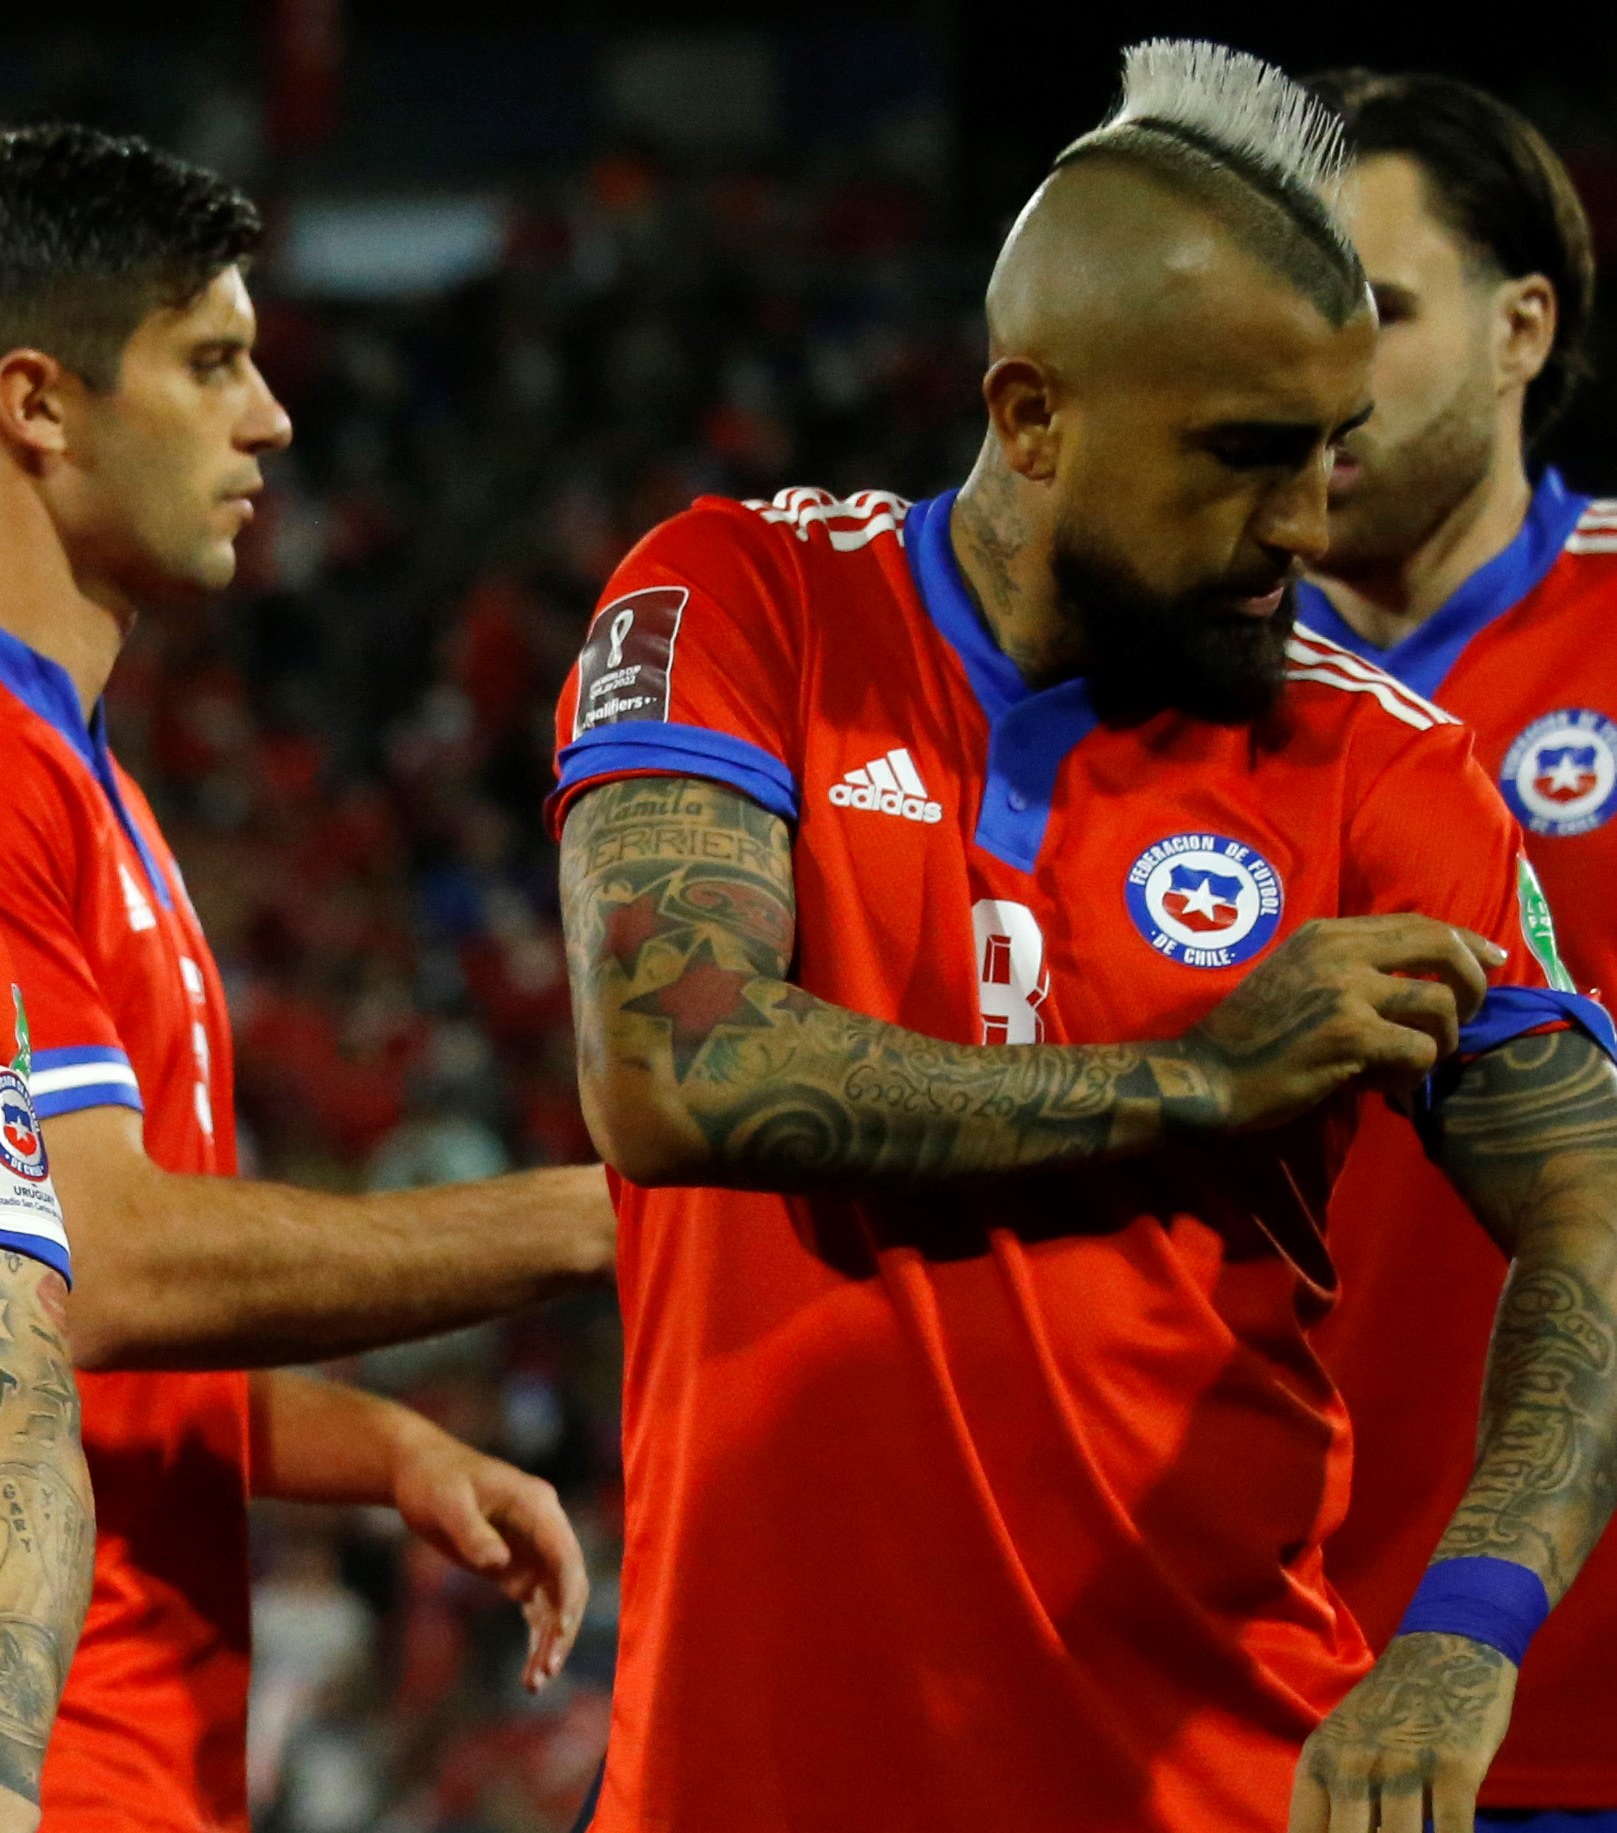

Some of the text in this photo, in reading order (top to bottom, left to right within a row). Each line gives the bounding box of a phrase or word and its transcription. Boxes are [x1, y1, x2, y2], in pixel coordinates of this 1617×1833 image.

[829, 785, 943, 824] adidas
[1129, 835, 1279, 916] FEDERACION DE FUTBOL
[1152, 935, 1232, 967] DE CHILE
